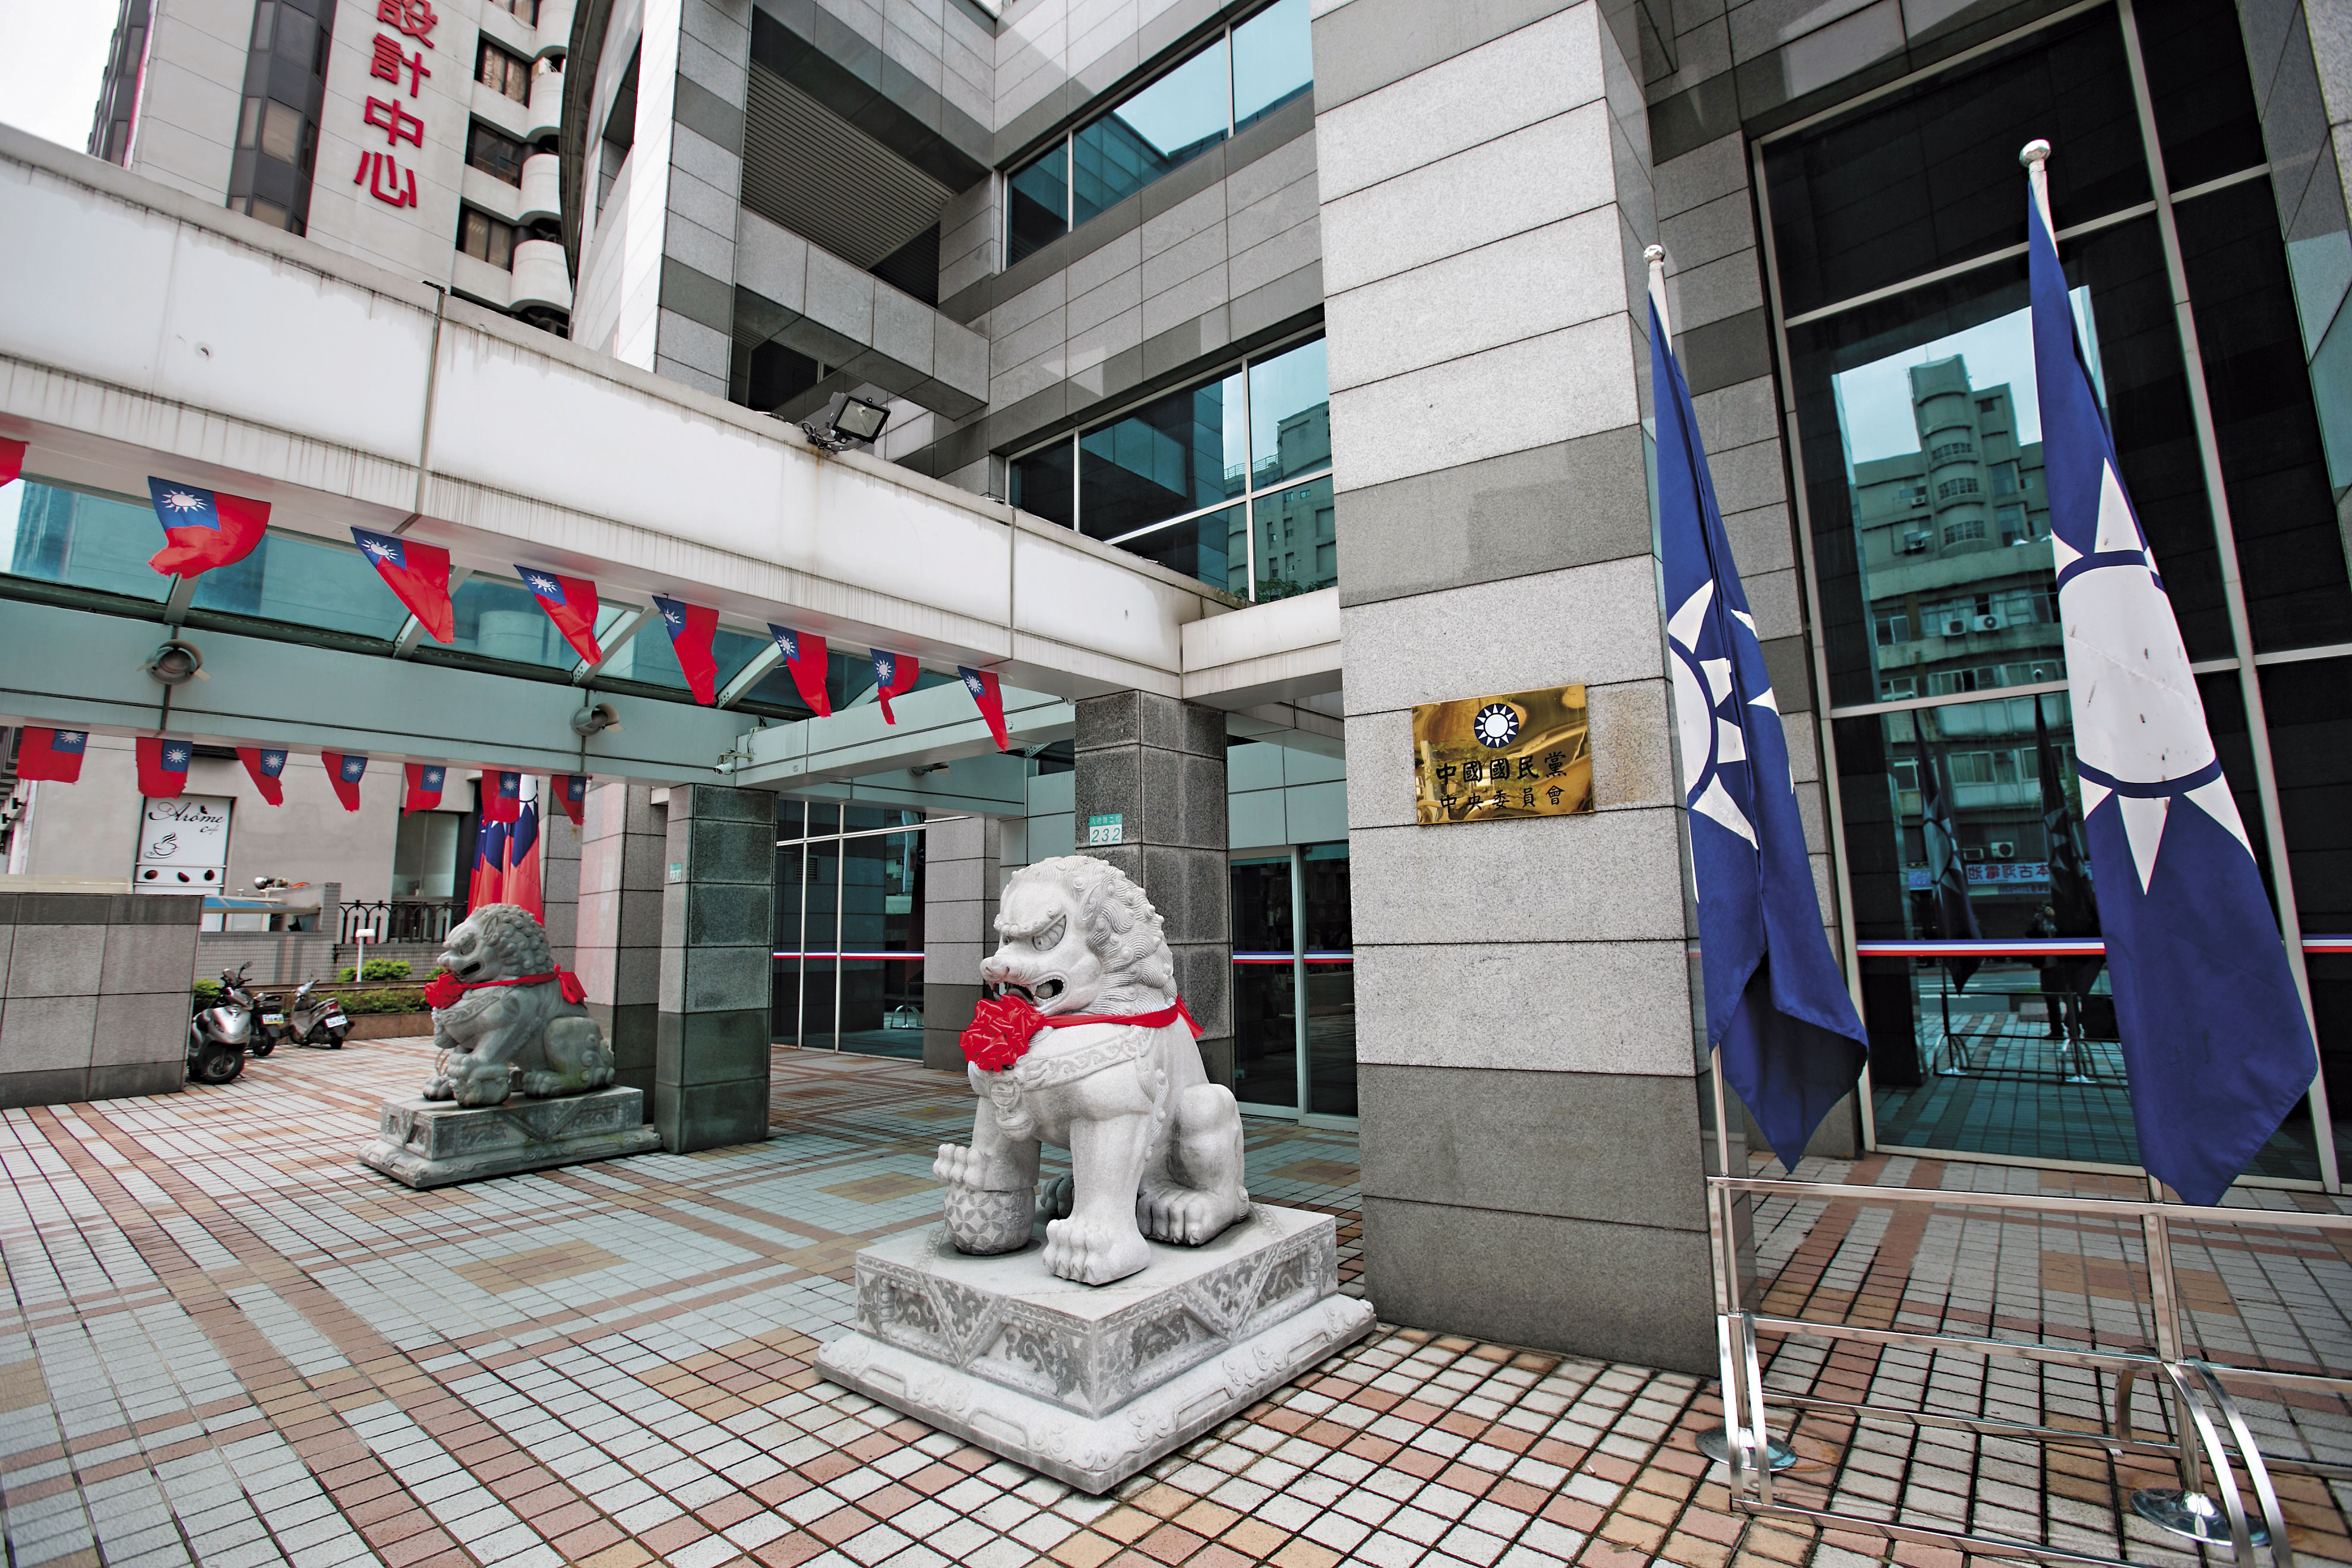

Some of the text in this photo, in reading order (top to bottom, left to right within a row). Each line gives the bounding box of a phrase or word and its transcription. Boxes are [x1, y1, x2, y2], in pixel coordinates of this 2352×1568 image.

[354, 0, 438, 208] 設計中心
[1436, 751, 1567, 786] 中國國民黨
[1440, 785, 1565, 813] 中央委員會
[1091, 827, 1121, 843] 232
